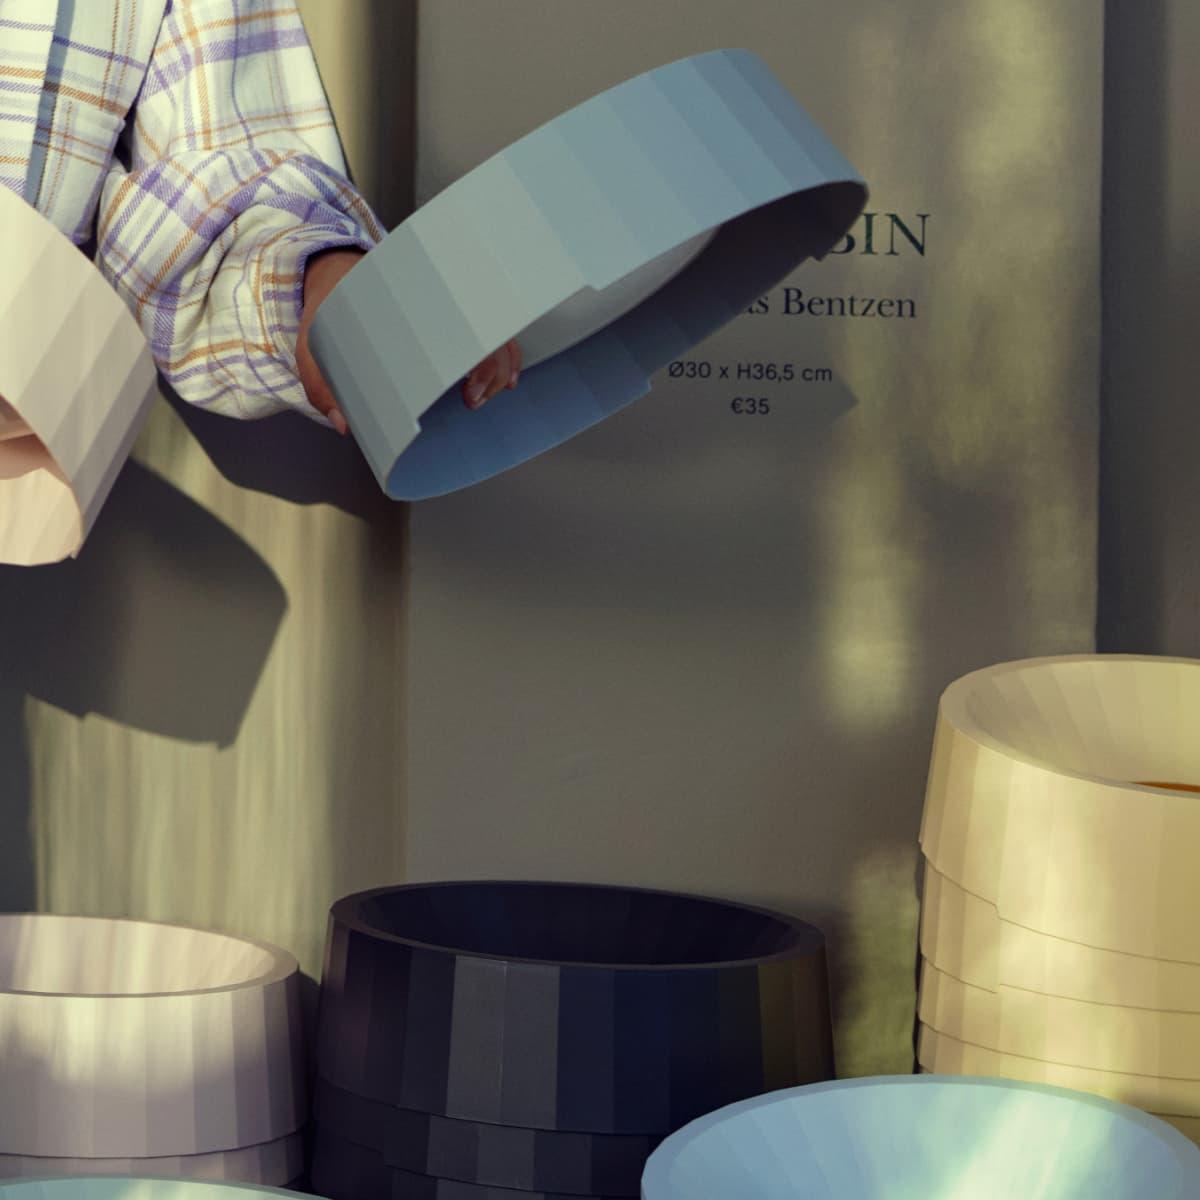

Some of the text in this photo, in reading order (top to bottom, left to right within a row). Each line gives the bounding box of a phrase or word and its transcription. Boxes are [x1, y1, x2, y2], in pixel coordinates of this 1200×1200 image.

[782, 287, 917, 319] Bentzen
[668, 360, 833, 383] Ø30 x H36,5 cm
[730, 396, 770, 415] €35
